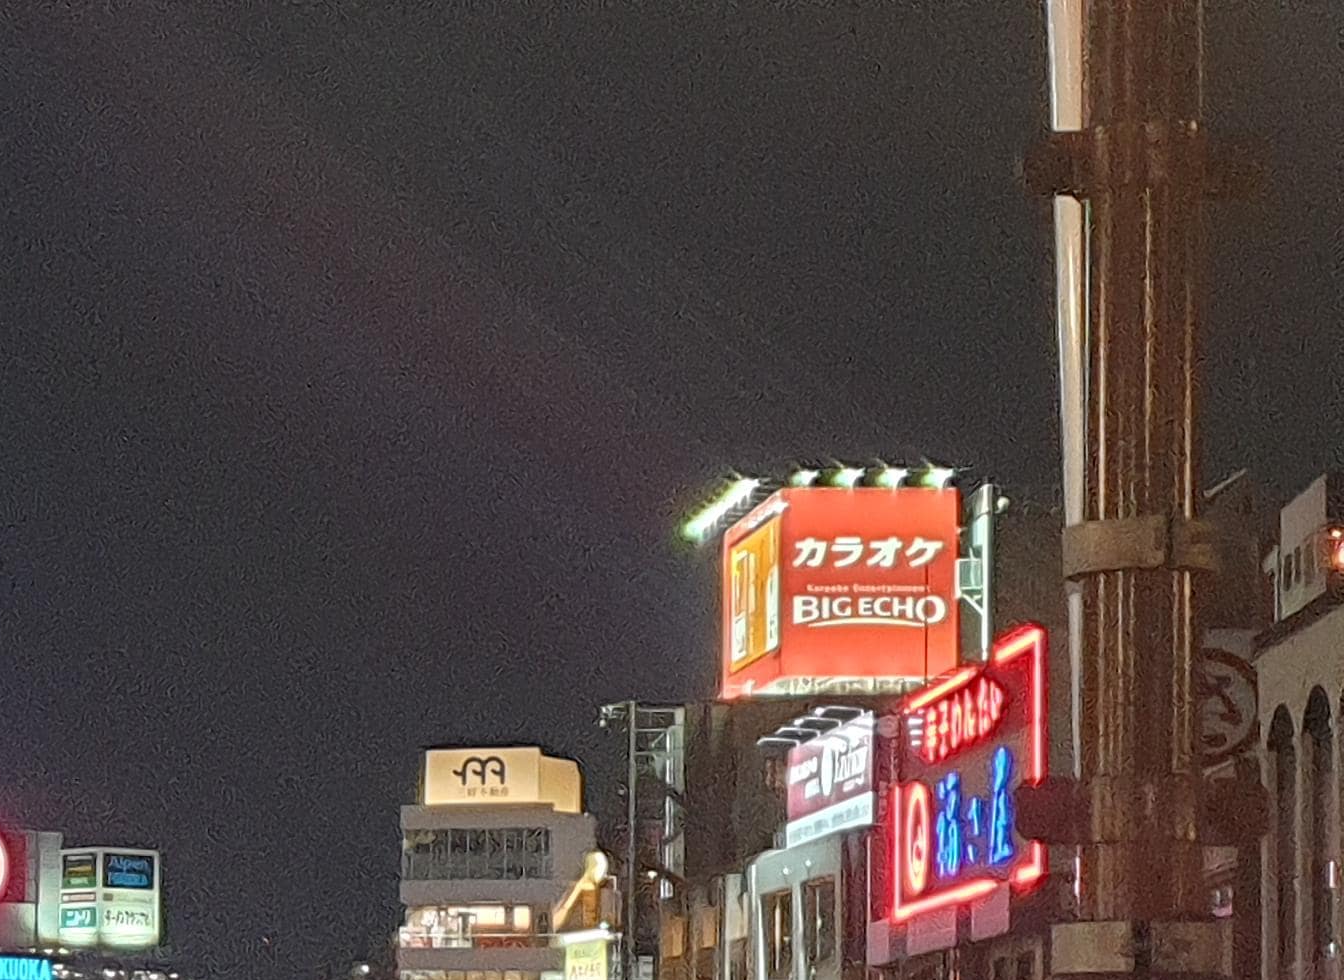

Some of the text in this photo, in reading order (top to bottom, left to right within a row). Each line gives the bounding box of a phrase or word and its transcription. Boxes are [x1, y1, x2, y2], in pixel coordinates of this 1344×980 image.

[792, 536, 944, 568] カラオケ
[792, 594, 948, 624] BIG ECHO
